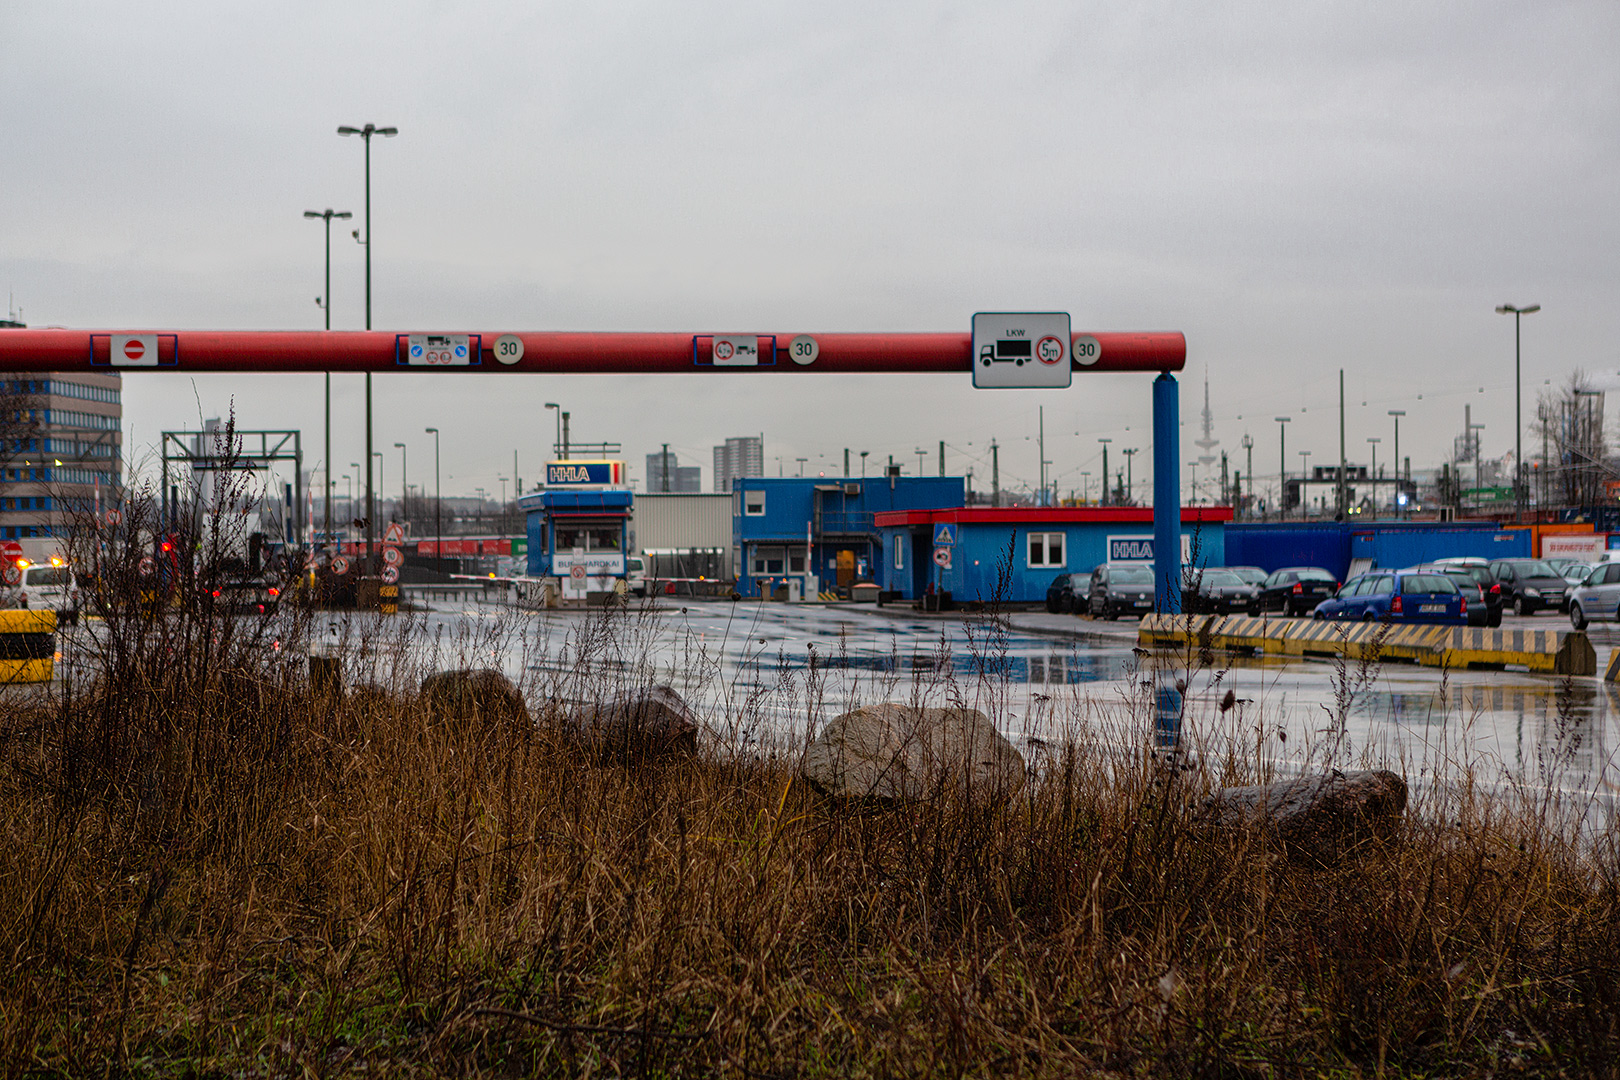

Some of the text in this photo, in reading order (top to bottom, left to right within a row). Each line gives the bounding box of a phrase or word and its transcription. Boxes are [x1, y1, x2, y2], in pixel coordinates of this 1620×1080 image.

[1006, 329, 1025, 337] LKW
[500, 342, 517, 356] 30
[795, 342, 812, 356] 30
[1042, 343, 1058, 357] 5m
[1078, 343, 1095, 357] 30
[550, 466, 590, 482] HHLA
[1113, 542, 1153, 558] HHLA
